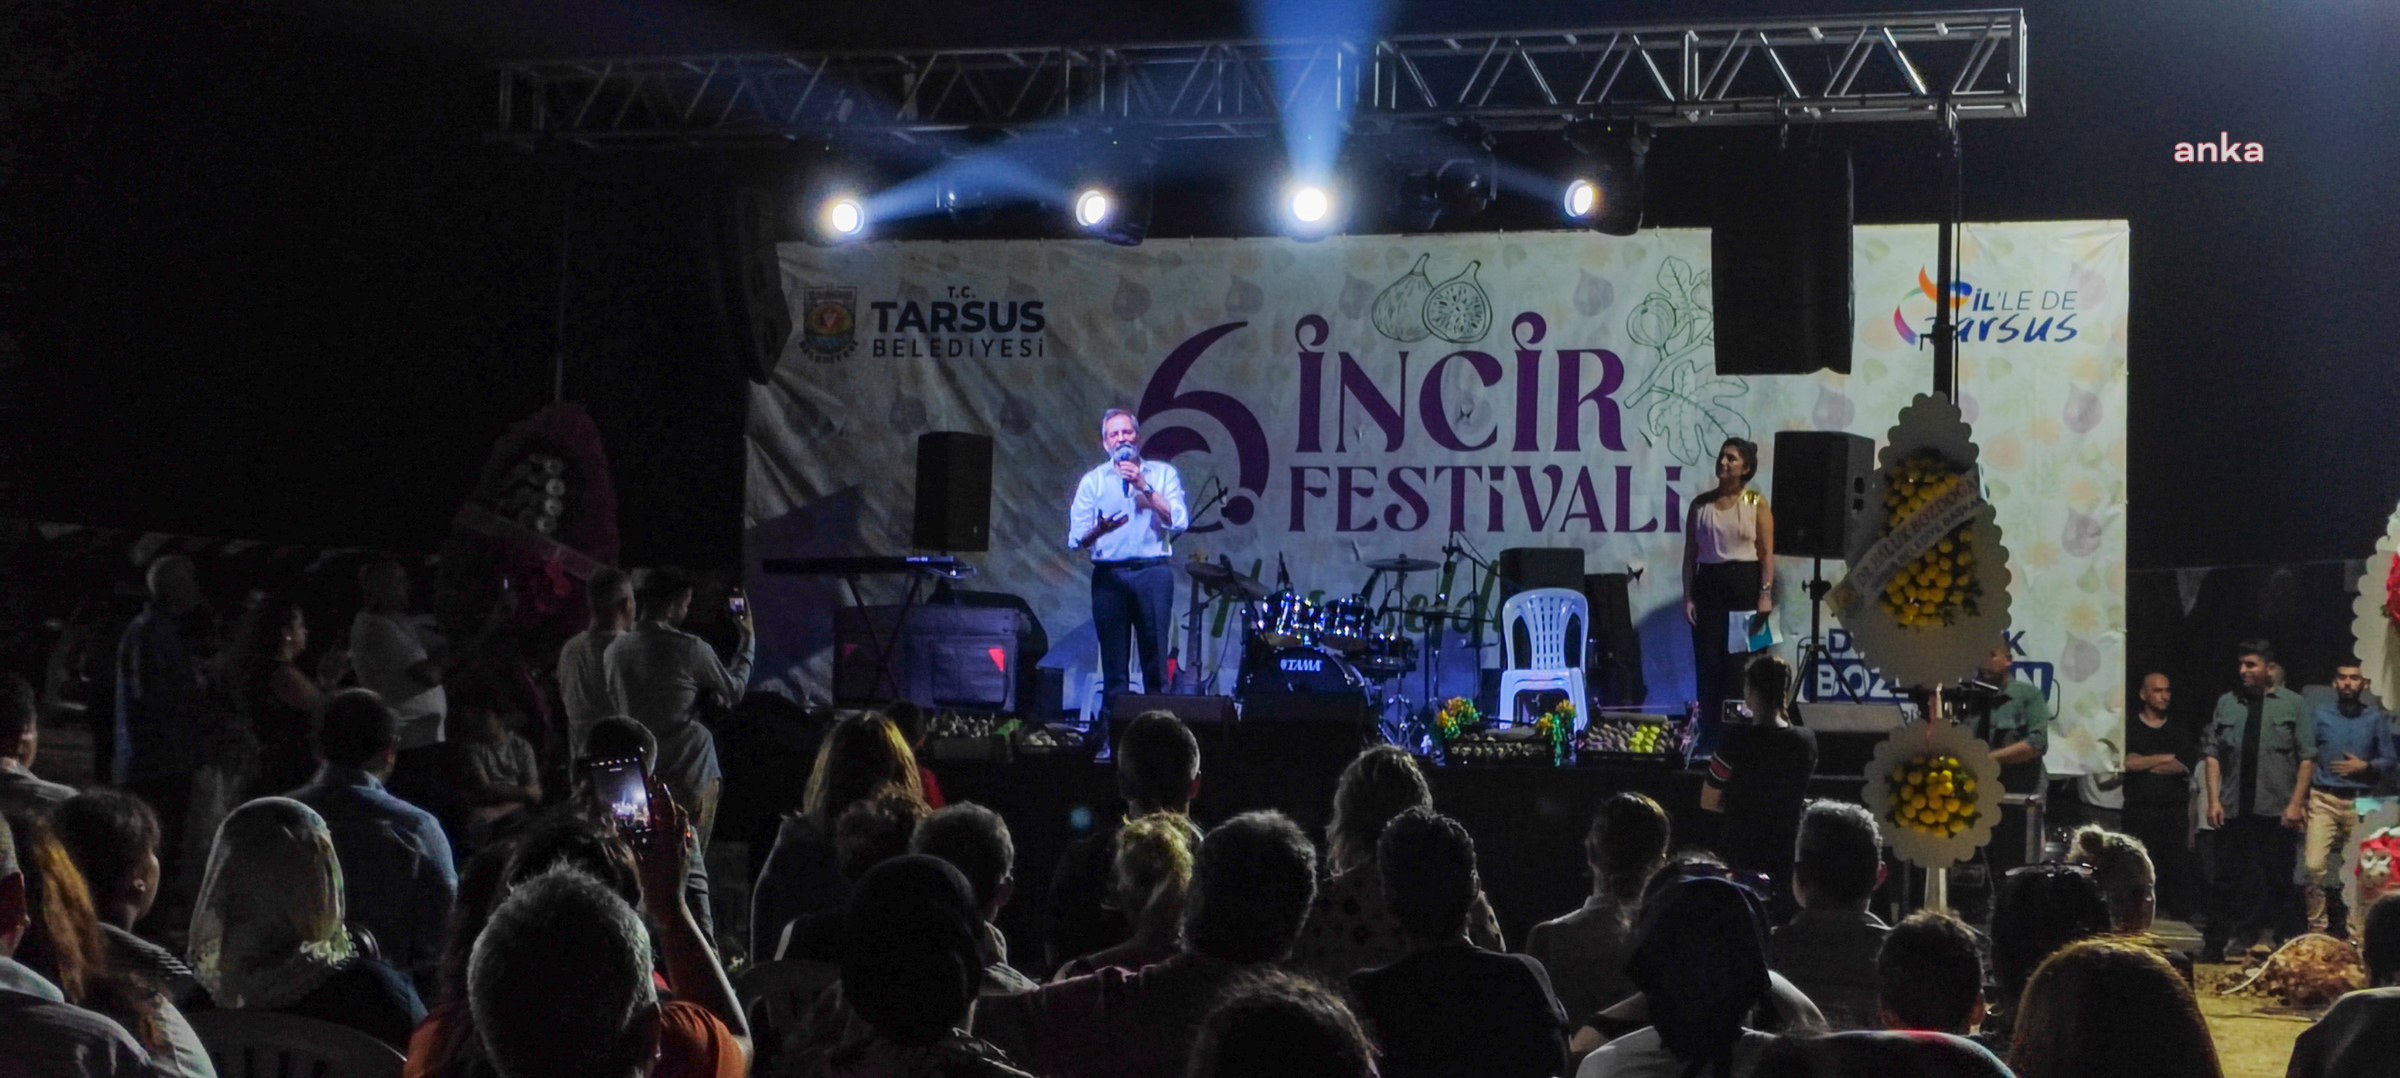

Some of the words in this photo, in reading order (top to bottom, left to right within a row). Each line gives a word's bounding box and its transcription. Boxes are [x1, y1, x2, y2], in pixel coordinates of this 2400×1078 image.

[947, 286, 976, 299] T.C.
[2041, 290, 2078, 311] DE
[871, 301, 1045, 333] TARSUS
[1925, 313, 2077, 343] arsus
[873, 337, 1043, 357] BELEDİYESİ
[1295, 312, 1627, 453] İNCİR
[1289, 465, 1682, 533] FESTİVALİ
[1287, 659, 1323, 672] TAMA
